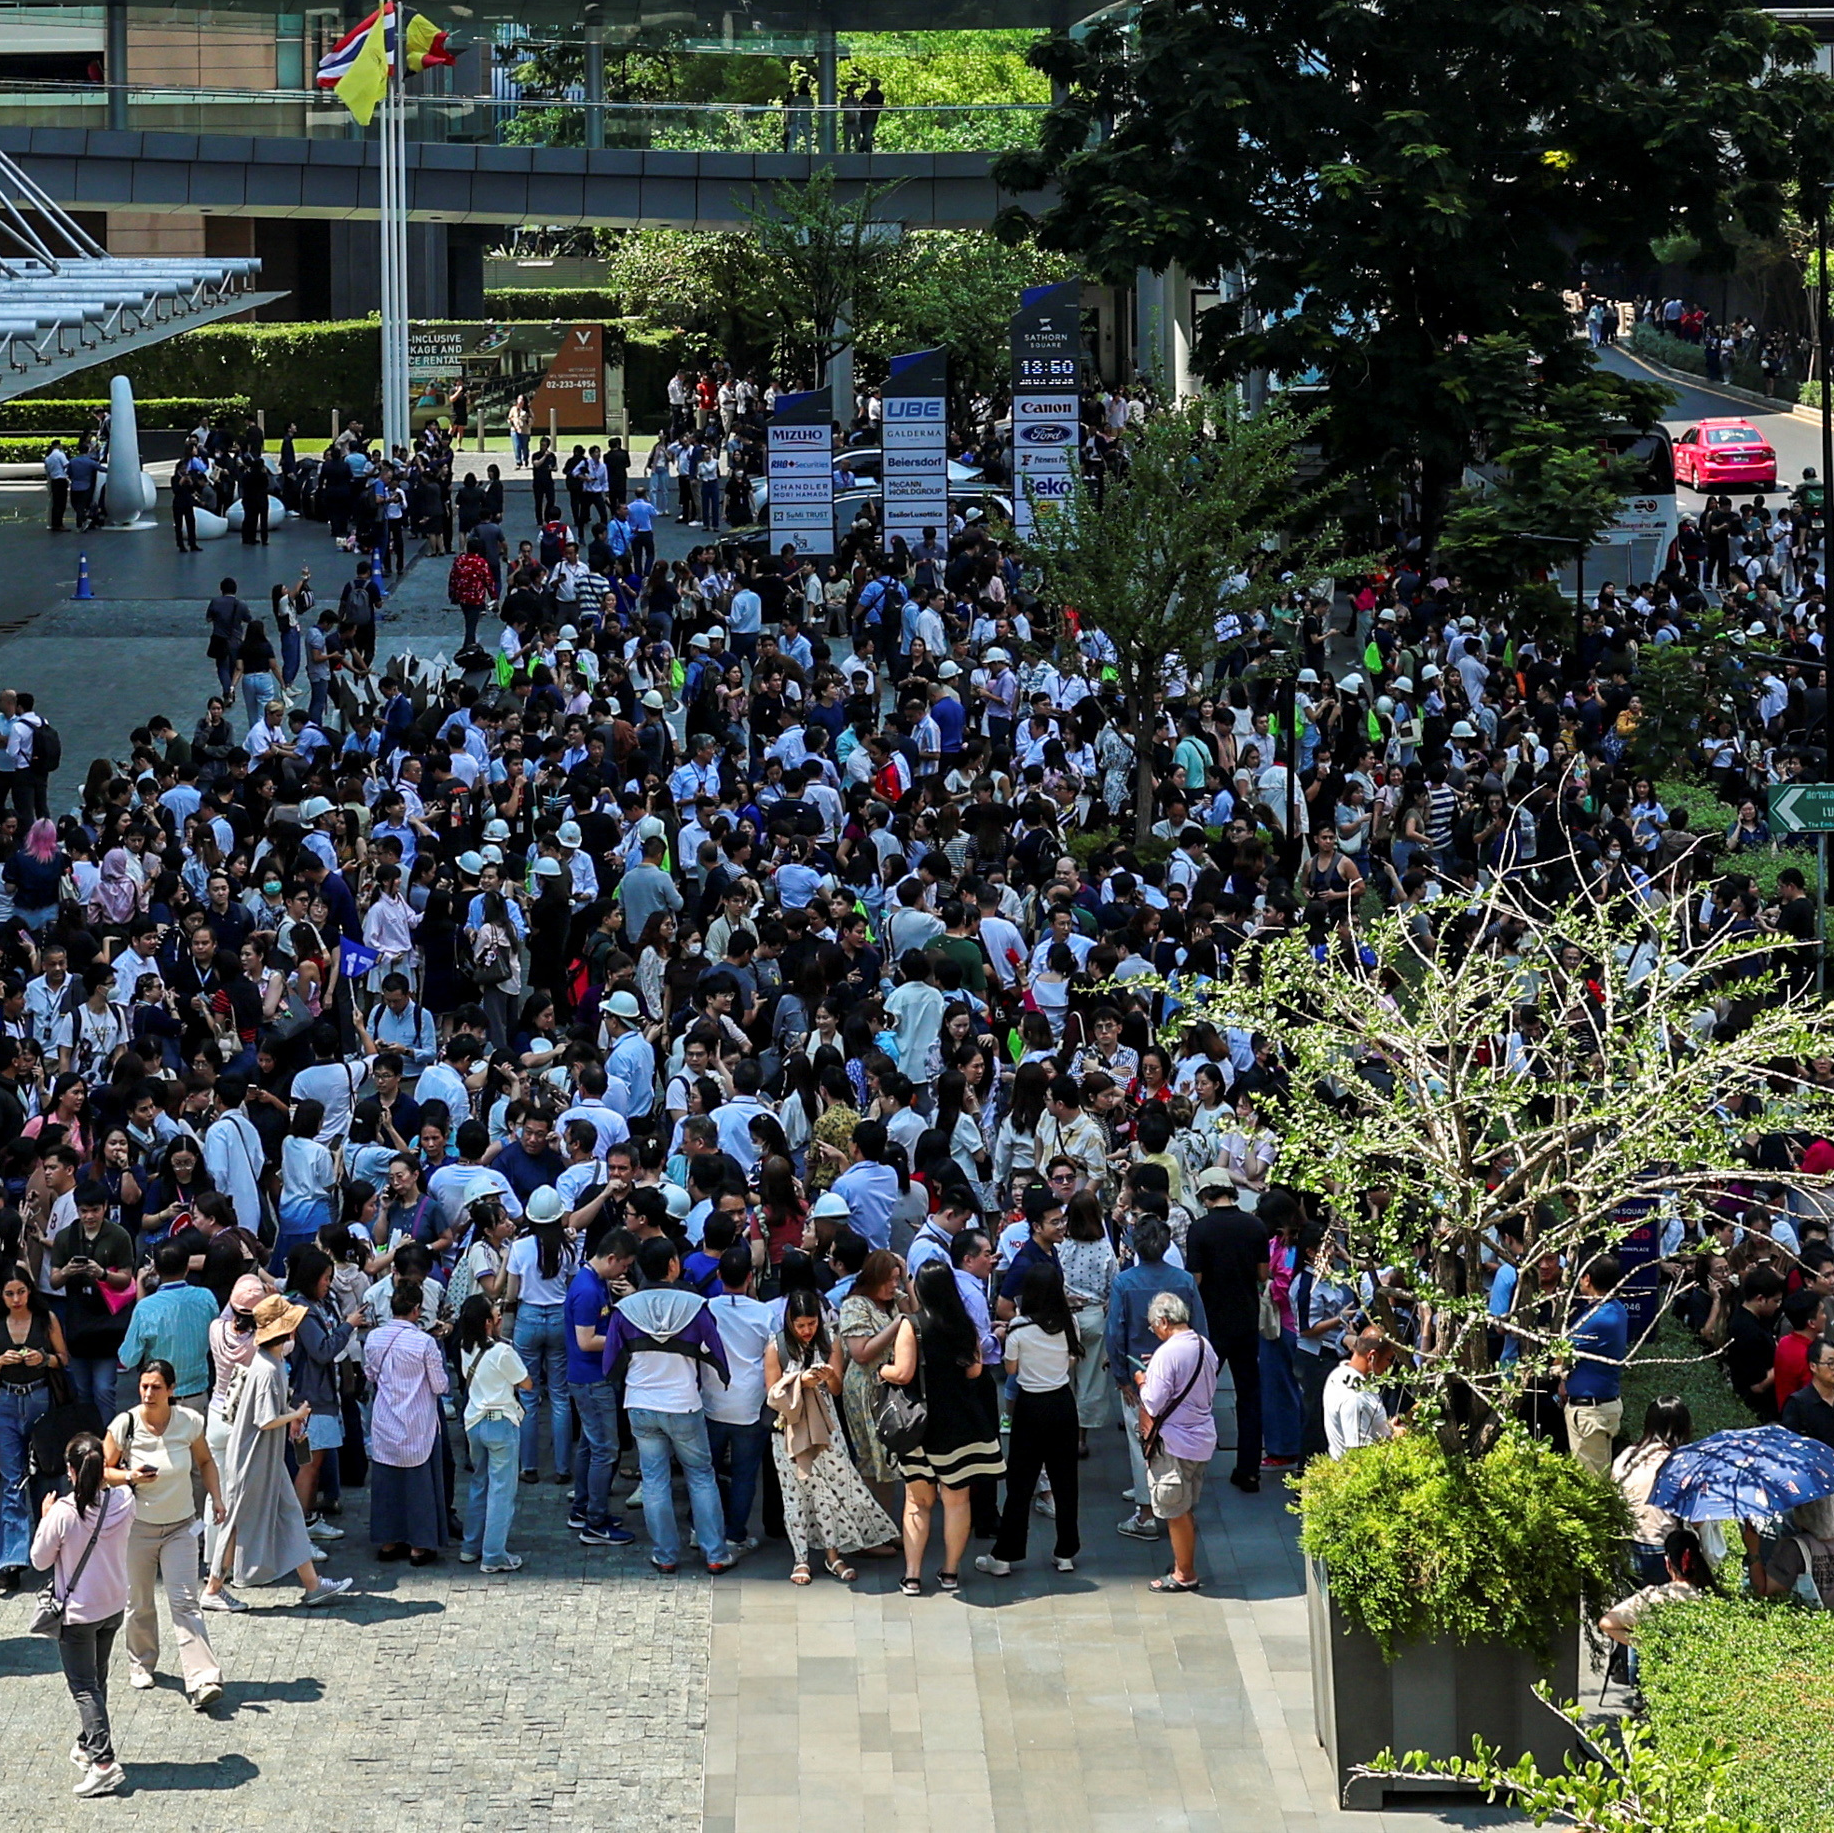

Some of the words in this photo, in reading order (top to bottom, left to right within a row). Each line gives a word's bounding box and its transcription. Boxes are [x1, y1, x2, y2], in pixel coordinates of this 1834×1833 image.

[409, 345, 437, 354] KAGE
[441, 345, 462, 354] AND
[423, 355, 461, 365] RENTAL
[546, 380, 596, 388] 02-233-4956
[887, 401, 940, 417] UBE
[1021, 402, 1072, 413] Canon
[772, 430, 823, 440] MIZUHO
[887, 430, 942, 438] GALDERMA
[1030, 427, 1063, 440] Ford
[888, 457, 942, 467] Beiersdorf
[1034, 455, 1058, 464] fitness
[771, 460, 788, 469] RHB
[795, 461, 828, 469] Securities
[773, 483, 828, 491] CHANDLER
[1022, 478, 1072, 495] Beko
[889, 488, 942, 496] WORLDGROUP
